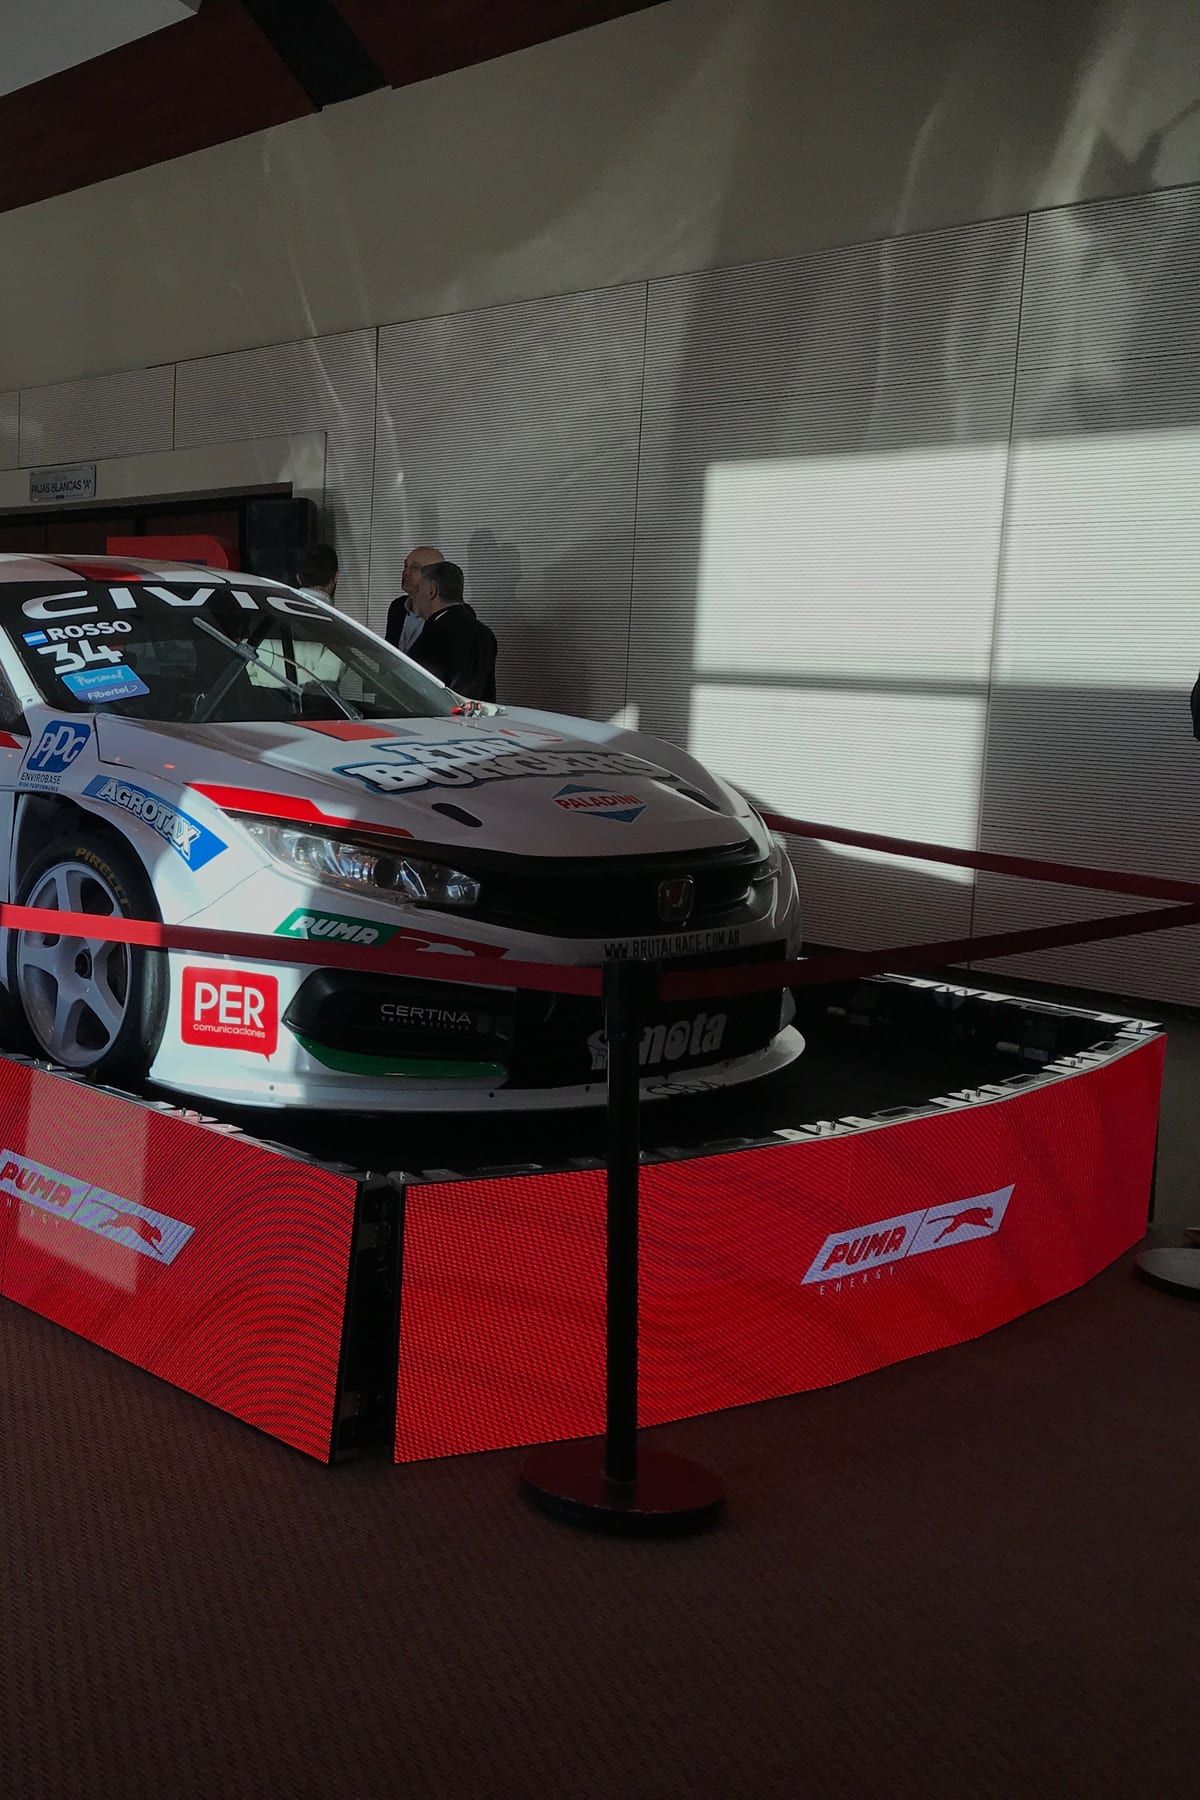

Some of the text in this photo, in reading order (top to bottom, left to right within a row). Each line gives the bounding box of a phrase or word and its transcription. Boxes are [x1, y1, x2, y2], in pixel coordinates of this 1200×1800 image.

[21, 586, 333, 621] CIVIC
[46, 620, 133, 641] ROSSO
[37, 639, 125, 675] 34
[88, 685, 130, 701] Fibertel
[20, 772, 62, 784] ENVIROBASE
[344, 751, 673, 792] BURGERS
[555, 793, 646, 810] PALADINI
[96, 778, 200, 859] AGROTAX
[75, 848, 129, 908] PIRELLI
[290, 915, 379, 945] PUMA
[194, 982, 265, 1028] PER
[380, 1003, 472, 1025] CERTINA
[193, 1023, 266, 1039] comunicaciones
[820, 1225, 907, 1272] PUMA
[818, 1266, 897, 1296] ENERGY
